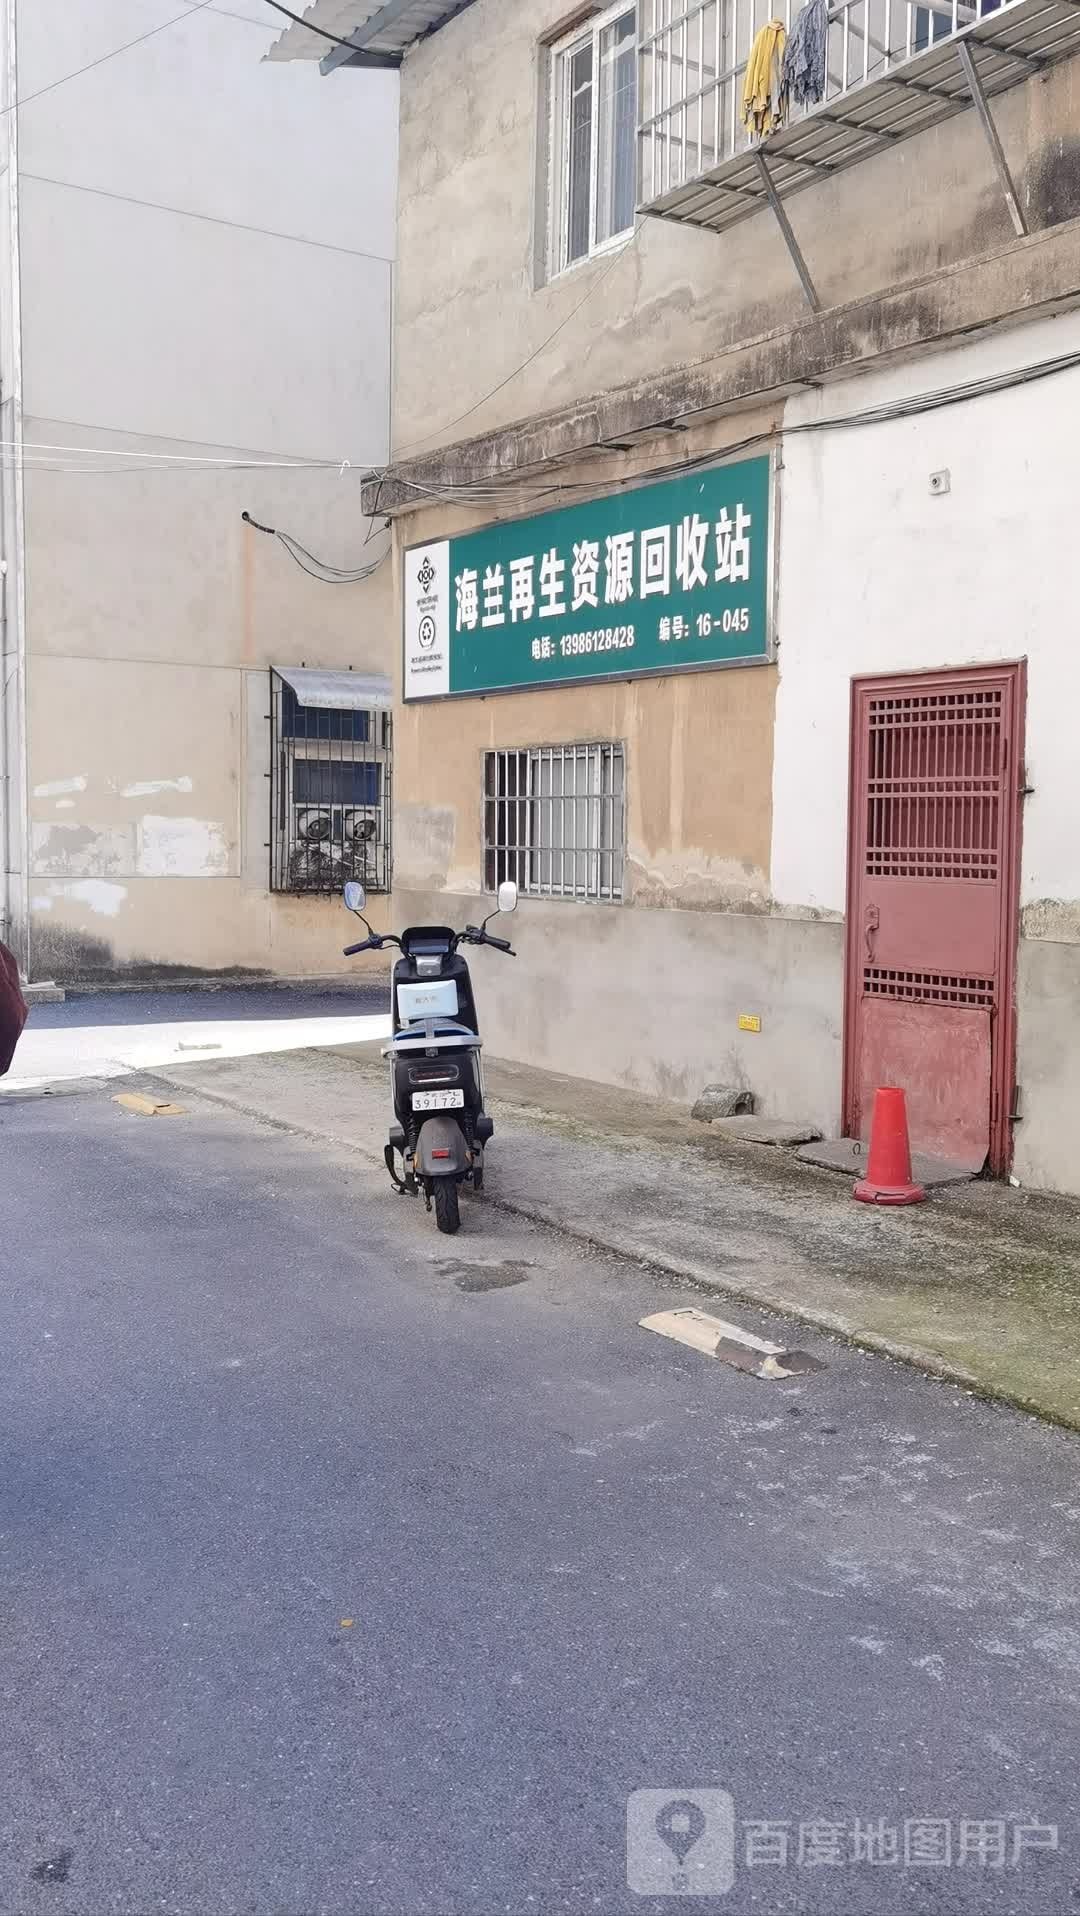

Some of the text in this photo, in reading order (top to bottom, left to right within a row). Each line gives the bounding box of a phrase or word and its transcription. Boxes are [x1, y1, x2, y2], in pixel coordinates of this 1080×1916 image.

[455, 503, 752, 632] 海兰再生资源回收站
[415, 1097, 456, 1109] 39172
